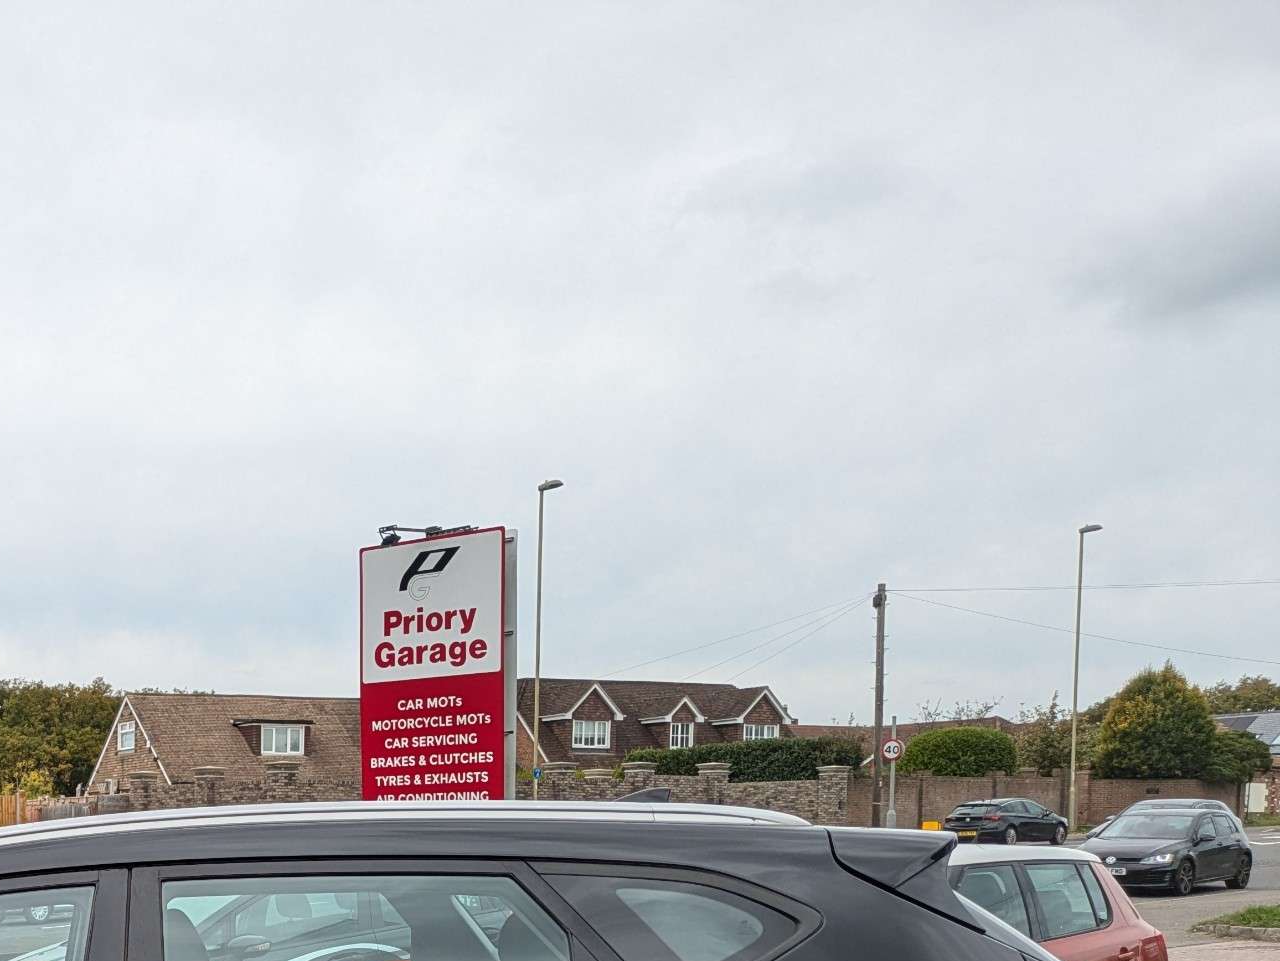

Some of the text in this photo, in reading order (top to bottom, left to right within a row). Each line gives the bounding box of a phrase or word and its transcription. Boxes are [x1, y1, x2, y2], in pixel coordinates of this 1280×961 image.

[384, 607, 477, 636] Priory
[374, 639, 487, 668] Garage
[397, 696, 462, 710] CAR MOTs
[372, 713, 491, 731] MOTORCYCLE MOTs
[384, 733, 477, 749] CAR SERVICING
[885, 745, 899, 754] 40
[370, 752, 494, 768] BRAKES & CLUTCHES
[375, 771, 489, 786] TYRES & EXHAUSTS
[401, 791, 489, 801] CONDITIONING
